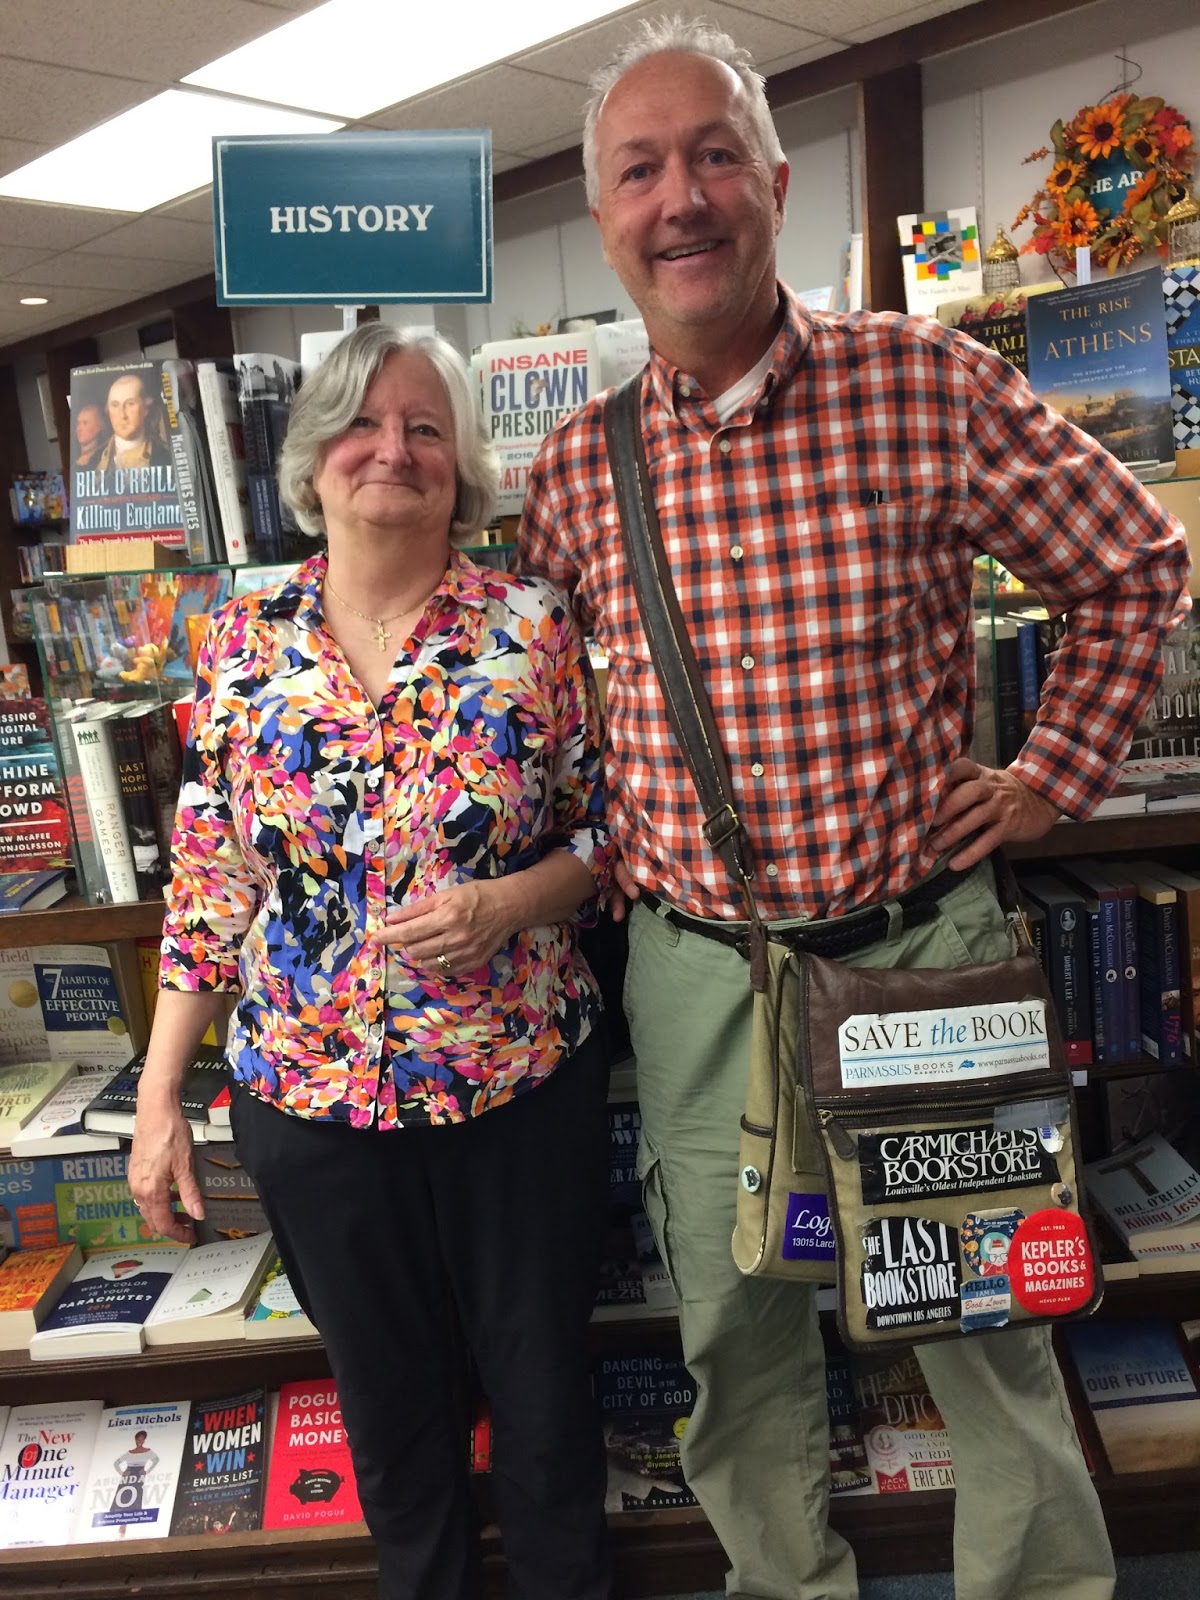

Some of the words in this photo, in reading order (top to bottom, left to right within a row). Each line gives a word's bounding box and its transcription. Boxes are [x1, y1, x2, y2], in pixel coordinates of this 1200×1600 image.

[270, 204, 434, 234] HISTORY
[1060, 304, 1091, 321] THE
[1098, 296, 1132, 315] RISE
[983, 324, 1011, 337] THE
[1090, 320, 1102, 329] OF
[1044, 321, 1153, 361] ATHENS
[490, 349, 588, 374] INSANE
[490, 365, 588, 413] CLOWN
[490, 407, 577, 439] PRESIDE
[216, 430, 226, 446] THE
[221, 449, 232, 479] SMEAR
[75, 468, 110, 498] BILL
[114, 464, 177, 495] O'REILL
[76, 504, 121, 532] Killing
[183, 500, 200, 531] SPIES
[0, 711, 37, 723] SSING
[0, 723, 39, 734] IGITAL
[1, 736, 24, 745] URE
[1144, 737, 1200, 759] HITLE
[0, 763, 49, 779] HINE
[118, 762, 145, 773] LAST
[120, 774, 147, 784] HOPE
[0, 782, 56, 798] FORM
[122, 784, 150, 794] ISLAND
[16, 831, 51, 842] McAFEE
[95, 809, 112, 856] GAMES
[106, 802, 126, 858] RANGER
[0, 840, 62, 853] YNJOLFSSON
[0, 949, 30, 963] field
[1063, 955, 1072, 979] ROBERT
[42, 968, 63, 1000] 7
[61, 975, 97, 985] HABITS
[98, 976, 110, 986] OF
[60, 988, 104, 999] HIGHLY
[1065, 989, 1073, 1001] LEE
[45, 999, 120, 1012] EFFECTIVE
[65, 1012, 108, 1022] PEOPLE
[844, 1021, 922, 1053] SAVE
[931, 1017, 968, 1047] the
[971, 1009, 1045, 1043] BOOK
[1162, 1015, 1181, 1046] 1776
[97, 1064, 107, 1072] R.
[846, 1063, 912, 1080] PARNASSUS
[914, 1061, 954, 1071] BOOKS
[977, 1052, 1048, 1069] www.parnassusbooks.net
[102, 1094, 137, 1103] ALEXAN
[62, 1156, 129, 1180] RETIRE
[883, 1146, 1041, 1186] BOOKSTORE
[205, 1176, 236, 1187] BOSS
[885, 1183, 930, 1196] Louisville's
[931, 1181, 958, 1191] Oldest
[958, 1176, 1006, 1189] Independent
[1007, 1171, 1043, 1183] Bookstore
[73, 1183, 134, 1203] PSYCHO
[1114, 1202, 1143, 1216] BILL
[1147, 1173, 1199, 1207] O'REILLY
[76, 1202, 141, 1220] REINVEN
[1123, 1210, 1173, 1230] Killing
[1173, 1192, 1200, 1216] Jesu
[791, 1209, 832, 1238] Log
[792, 1237, 815, 1247] 13015
[881, 1217, 950, 1269] LAST
[1021, 1236, 1086, 1260] KEPLER'S
[1023, 1259, 1080, 1277] BOOKS
[1079, 1260, 1087, 1270] &
[81, 1282, 109, 1292] WHAT
[113, 1280, 149, 1288] COLOR
[863, 1261, 959, 1309] BOOKSTORE
[965, 1277, 1006, 1292] HELLO
[1025, 1277, 1085, 1293] MAGAZINES
[58, 1294, 153, 1310] PARACHUTE?
[876, 1311, 913, 1327] DOWNTOWN
[913, 1309, 925, 1321] LOS
[926, 1305, 952, 1320] ANGELES
[602, 1357, 662, 1374] DANCING
[616, 1375, 657, 1389] DEVIL
[855, 1356, 919, 1409] HEAVE
[1086, 1375, 1121, 1392] OUR
[1125, 1369, 1189, 1387] FUTURE
[288, 1391, 338, 1410] POGU
[602, 1393, 633, 1409] CITY
[640, 1392, 657, 1406] OF
[663, 1389, 692, 1405] GOD
[204, 1402, 257, 1432] WHEN
[882, 1393, 939, 1425] DITC
[107, 1417, 132, 1428] Lisa
[135, 1413, 182, 1425] Nichols
[290, 1410, 342, 1428] BASIC
[17, 1433, 37, 1443] The
[39, 1429, 75, 1445] New
[193, 1421, 262, 1455] WOMEN
[17, 1442, 68, 1469] One
[206, 1447, 246, 1474] WIN
[908, 1448, 951, 1460] MURD
[2, 1463, 75, 1482] Minute
[94, 1471, 173, 1487] ABUNDANCE
[193, 1474, 230, 1487] EMILY'S
[232, 1469, 254, 1481] LIST
[881, 1477, 905, 1485] JACK
[913, 1469, 936, 1488] ERIE
[834, 1477, 869, 1489] SAKAMOTO
[880, 1483, 909, 1491] KELLY
[90, 1483, 171, 1511] NOW
[191, 1493, 213, 1501] ELLEN
[652, 1496, 697, 1505] BARBASS
[283, 1511, 311, 1522] DAVID
[314, 1508, 345, 1518] POGUE
